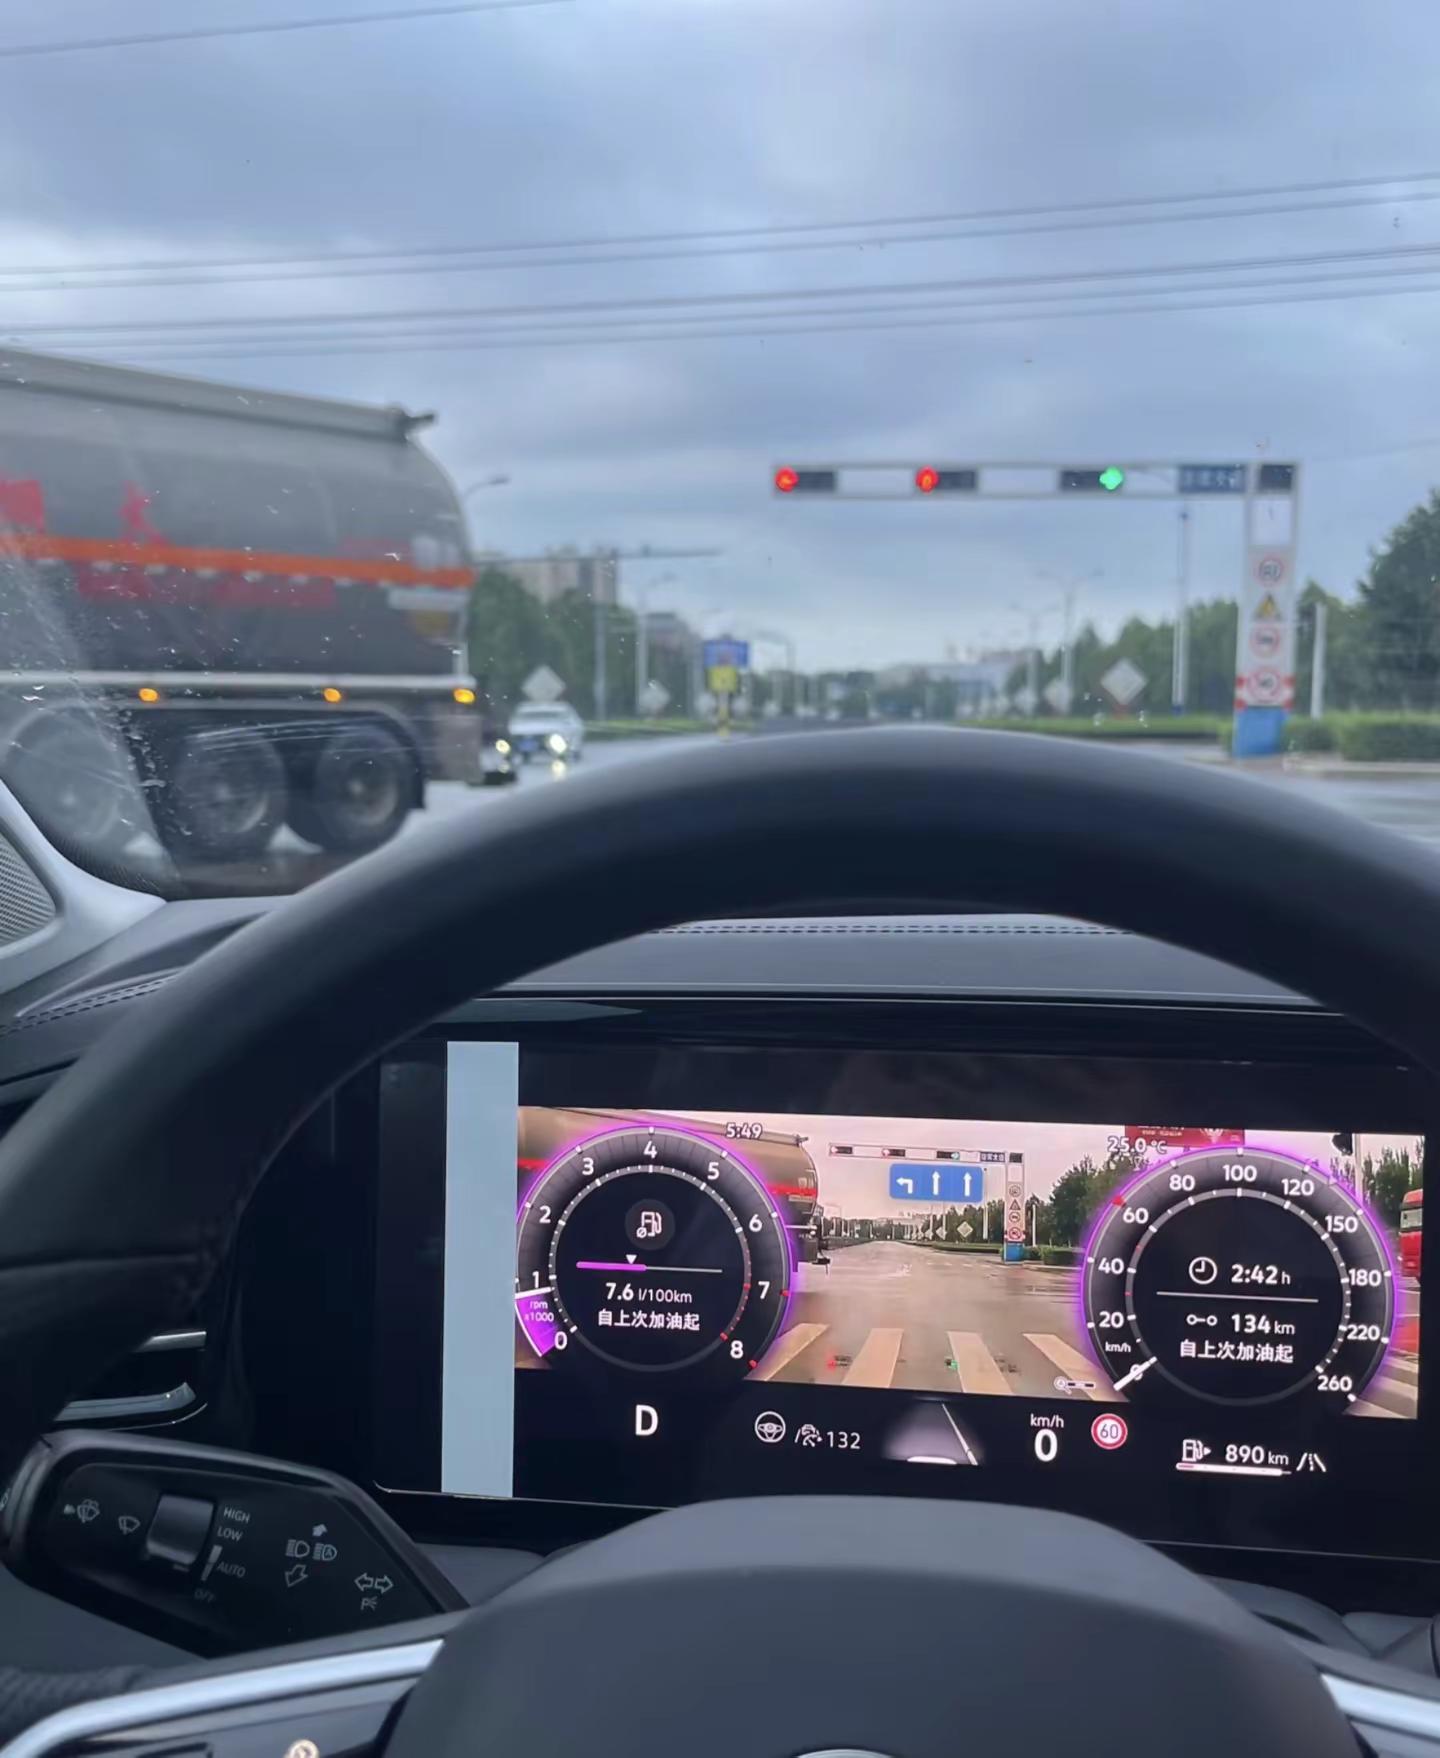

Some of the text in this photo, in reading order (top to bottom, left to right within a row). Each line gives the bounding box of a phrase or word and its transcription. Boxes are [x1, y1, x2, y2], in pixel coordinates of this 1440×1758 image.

[726, 1122, 762, 1139] 5:49
[644, 1141, 657, 1159] 4
[1107, 1136, 1147, 1153] 25.0
[582, 1158, 595, 1175] 3
[707, 1162, 720, 1180] 5
[1222, 1164, 1258, 1183] 100
[1169, 1174, 1196, 1192] 80
[1281, 1179, 1314, 1197] 120
[539, 1206, 551, 1224] 2
[749, 1214, 763, 1233] 6
[1123, 1207, 1149, 1225] 60
[1325, 1216, 1358, 1233] 150
[1098, 1258, 1125, 1275] 40
[1231, 1264, 1291, 1285] 2:42 h
[532, 1271, 540, 1289] 1
[1349, 1269, 1382, 1286] 180
[605, 1282, 634, 1301] 7.6
[758, 1281, 770, 1299] 7
[529, 1300, 548, 1311] rpm
[598, 1308, 700, 1331] 自上次加油起
[1099, 1311, 1125, 1328] 20
[1231, 1313, 1295, 1335] 134 km
[554, 1331, 568, 1350] 0
[1347, 1324, 1380, 1341] 220
[730, 1340, 744, 1358] 8
[1105, 1341, 1131, 1352] km/h
[1180, 1339, 1294, 1364] 自上次加油起
[1317, 1375, 1353, 1392] 260
[635, 1405, 658, 1437] D
[1030, 1413, 1064, 1428] km/h
[826, 1431, 861, 1449] 132
[1100, 1423, 1119, 1440] 60
[1034, 1428, 1058, 1462] 0
[1225, 1444, 1289, 1465] 890 km
[223, 1506, 250, 1524] HIGH
[217, 1526, 243, 1542] LOW
[217, 1561, 246, 1579] AUTO
